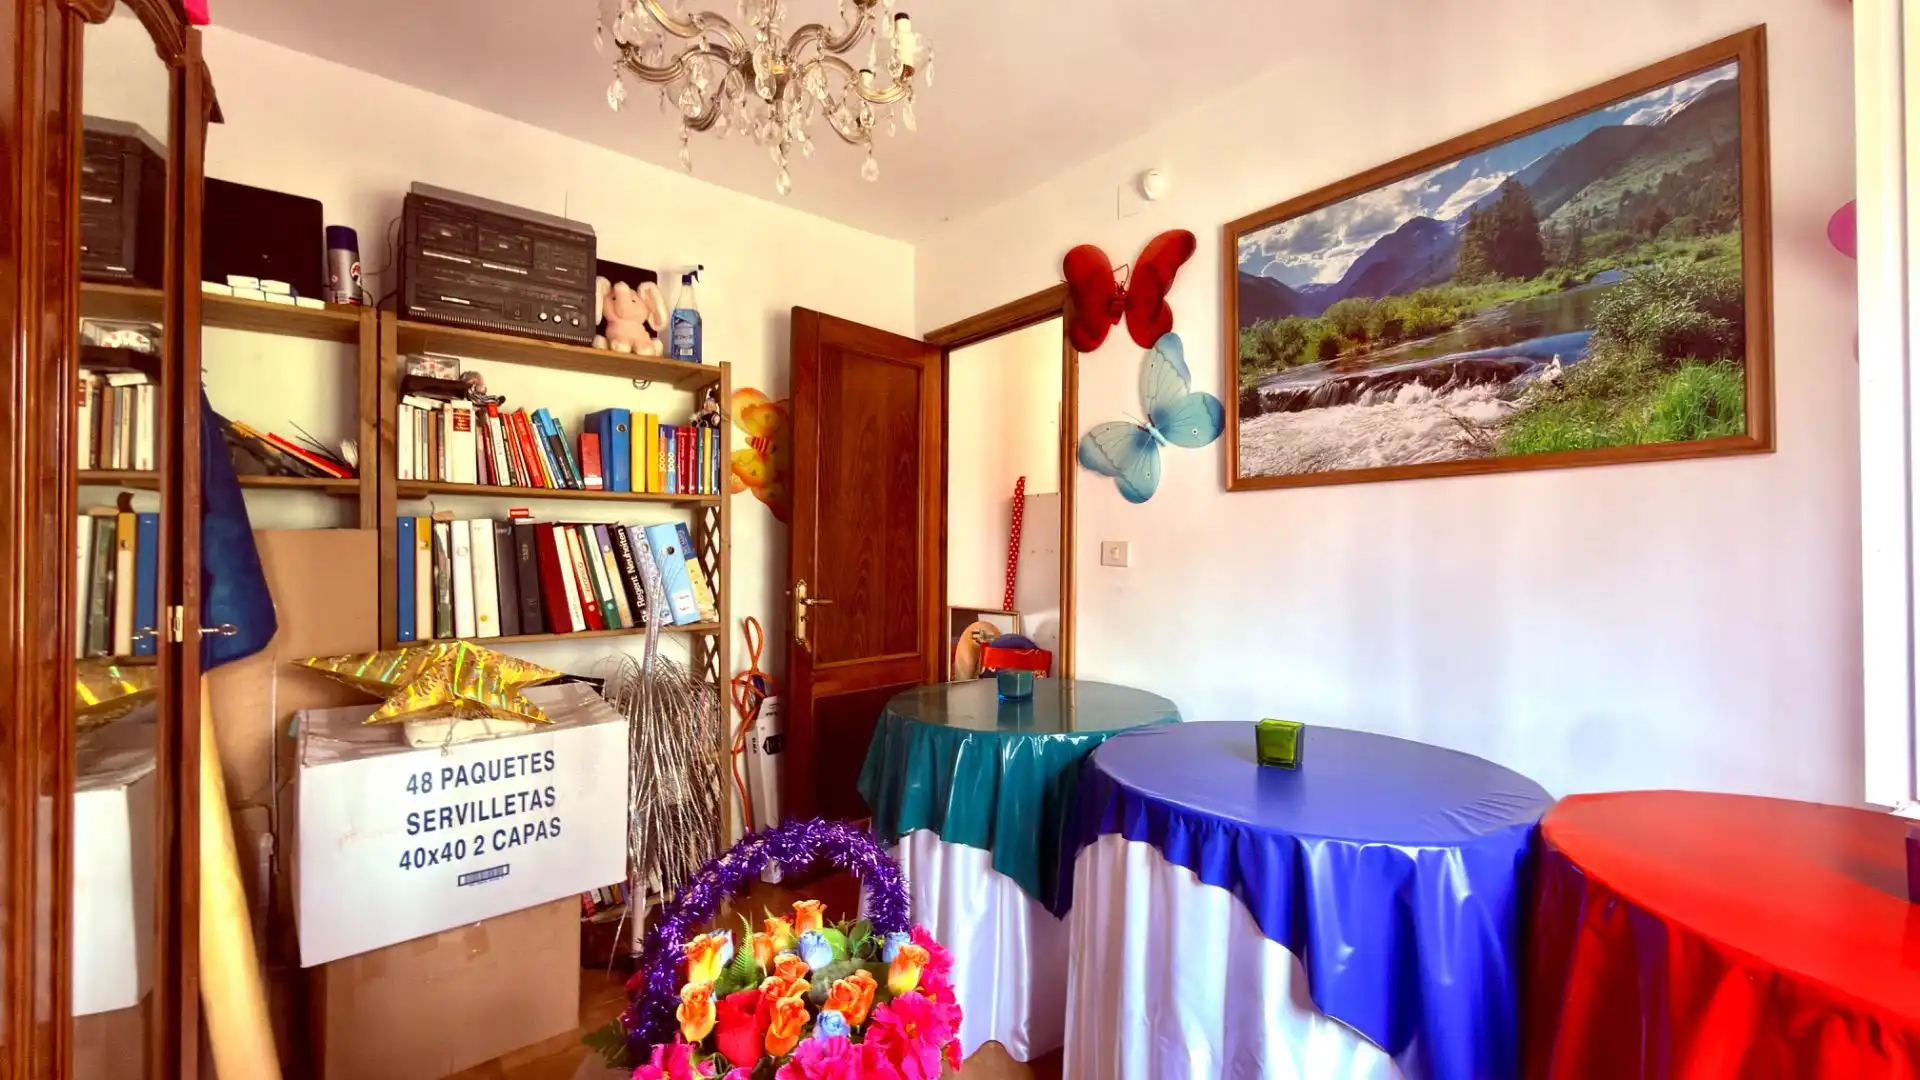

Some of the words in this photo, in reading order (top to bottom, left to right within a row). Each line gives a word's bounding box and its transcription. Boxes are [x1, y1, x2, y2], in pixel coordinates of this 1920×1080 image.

[617, 528, 636, 574] Neuheiten
[631, 575, 646, 608] Regent
[406, 771, 433, 795] 48
[441, 750, 556, 790] PAQUETES
[406, 786, 556, 835] SERVILLETAS
[399, 839, 466, 870] 40x40
[473, 835, 485, 856] 2
[492, 817, 562, 851] CAPAS
